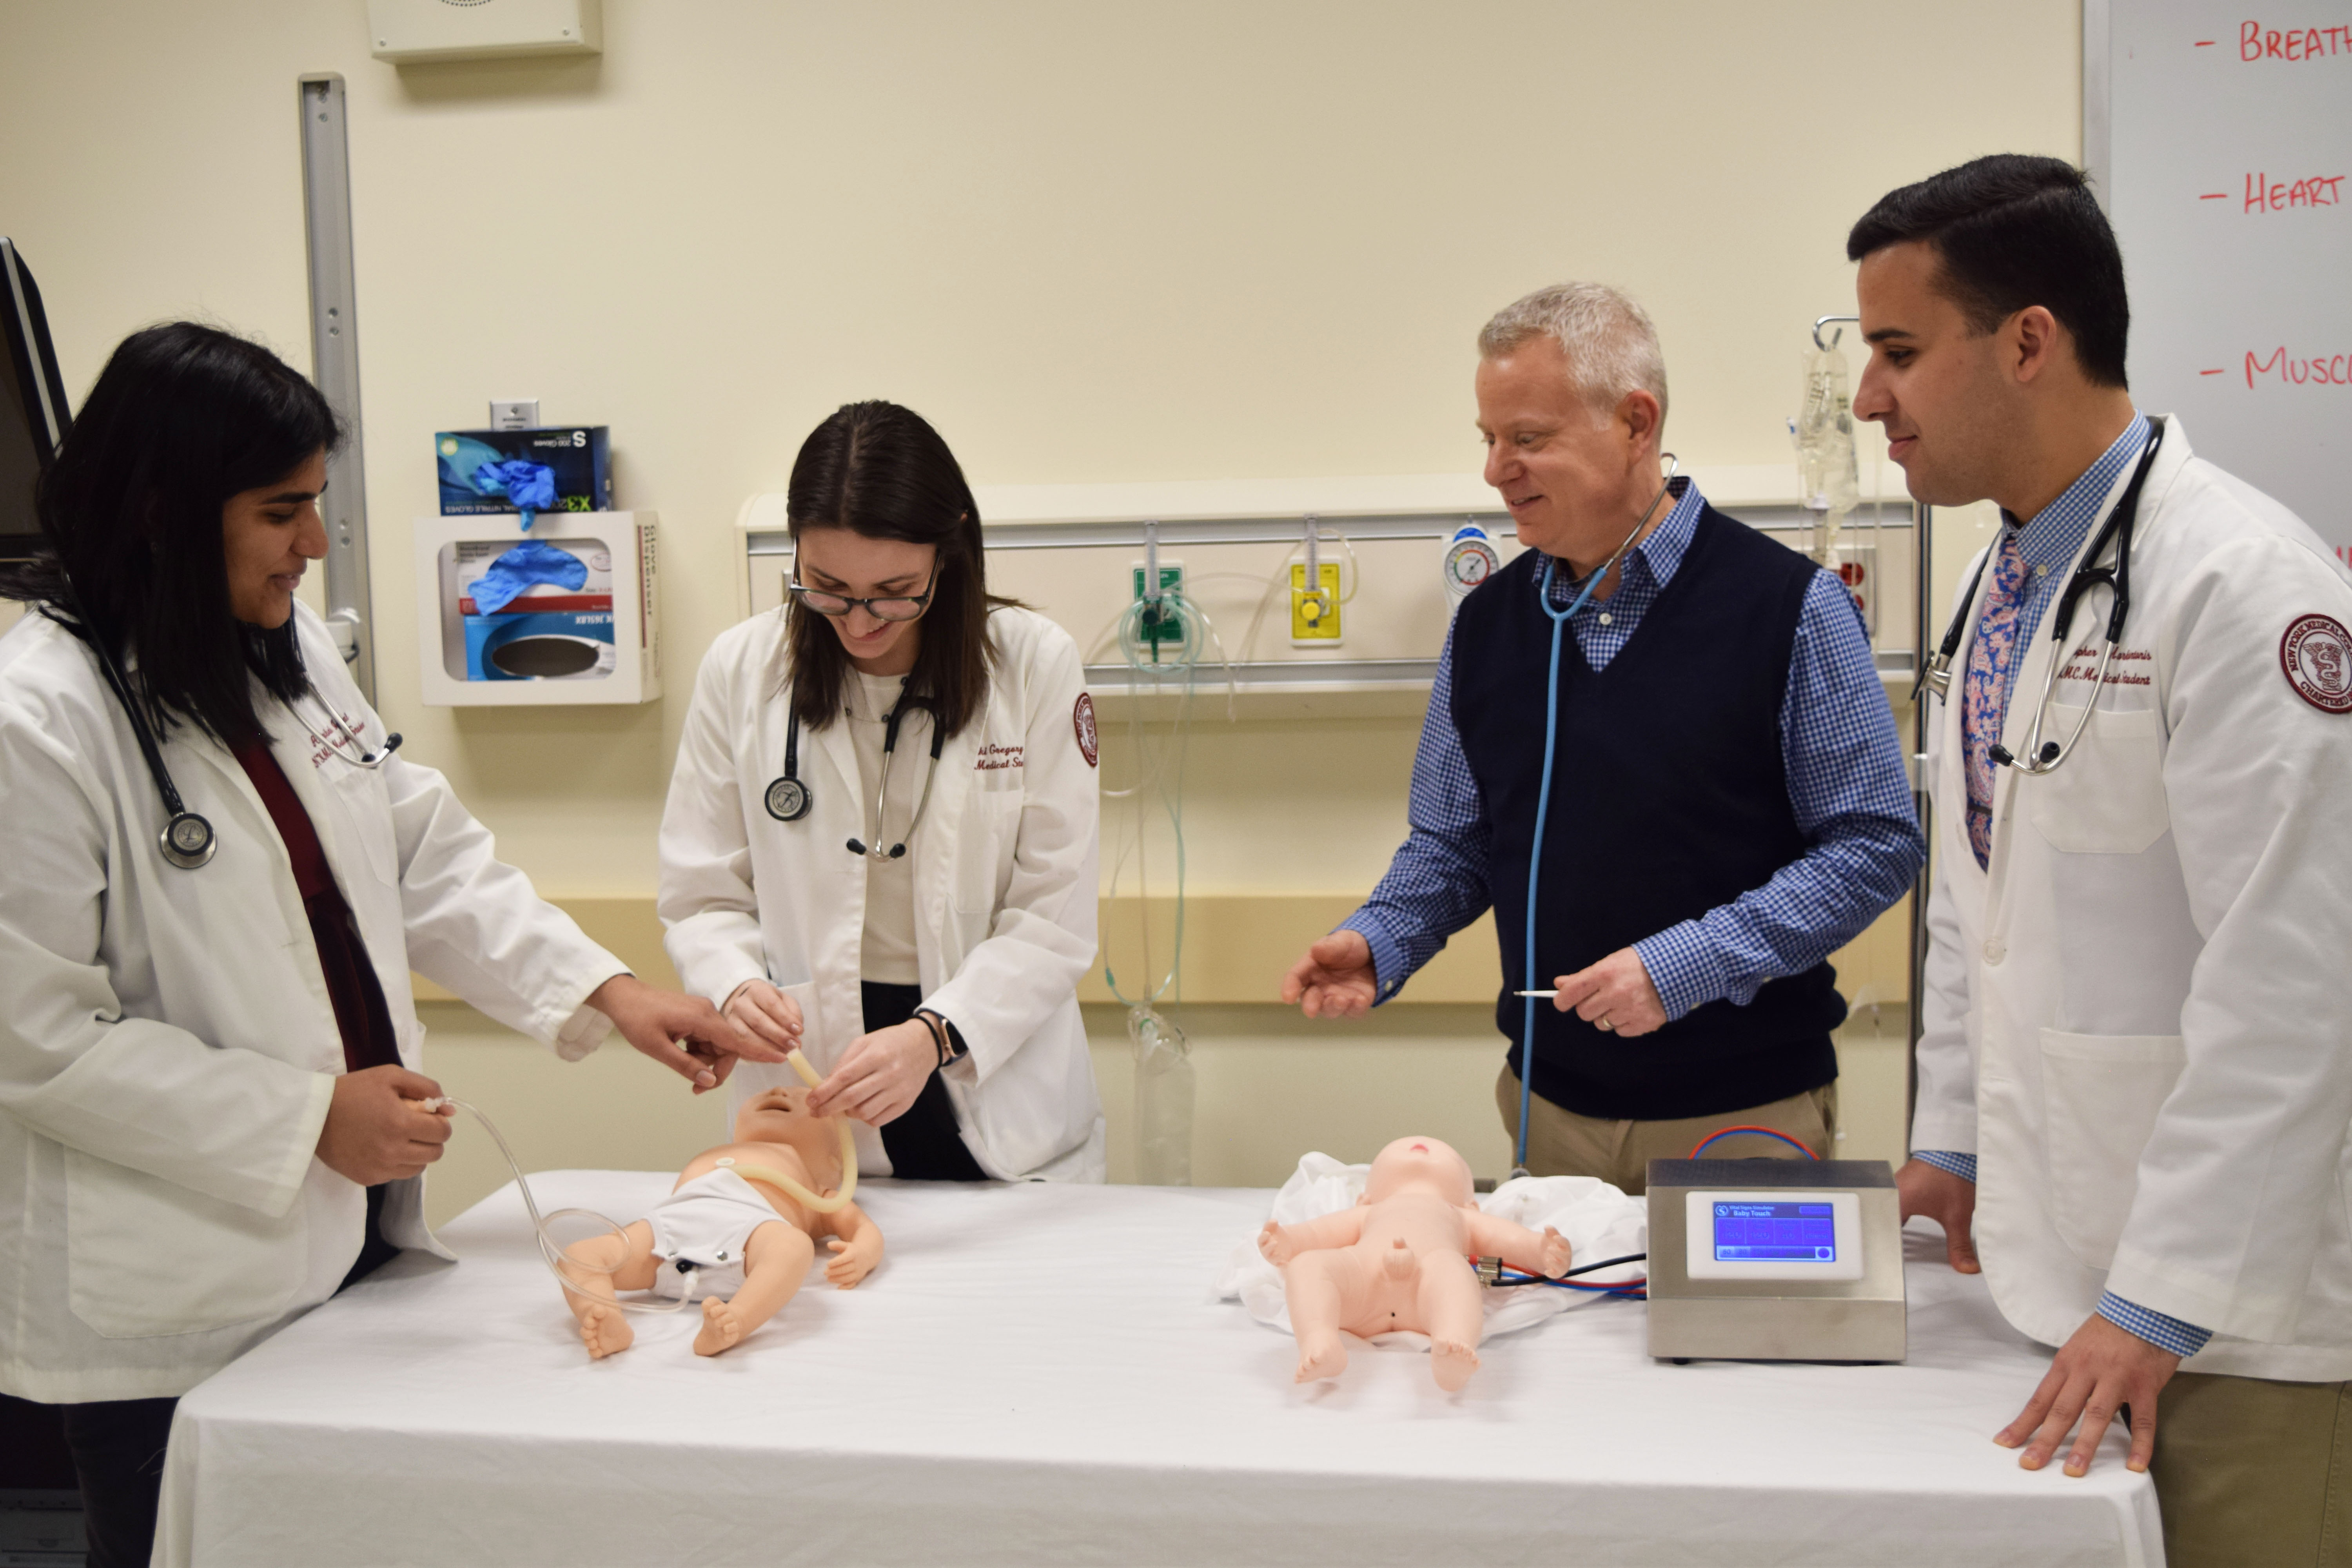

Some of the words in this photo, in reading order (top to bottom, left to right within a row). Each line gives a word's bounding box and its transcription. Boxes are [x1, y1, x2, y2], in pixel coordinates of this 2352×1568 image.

[2245, 172, 2345, 214] HEART
[572, 431, 586, 447] S
[566, 495, 593, 512] X3
[644, 525, 652, 618] Dispenser
[2288, 624, 2307, 649] YORK
[2303, 620, 2339, 637] MEDICAL
[2287, 648, 2299, 672] NEW
[2299, 681, 2349, 706] CHARTERED
[989, 744, 1024, 756] Gregory
[974, 759, 1010, 770] Medical
